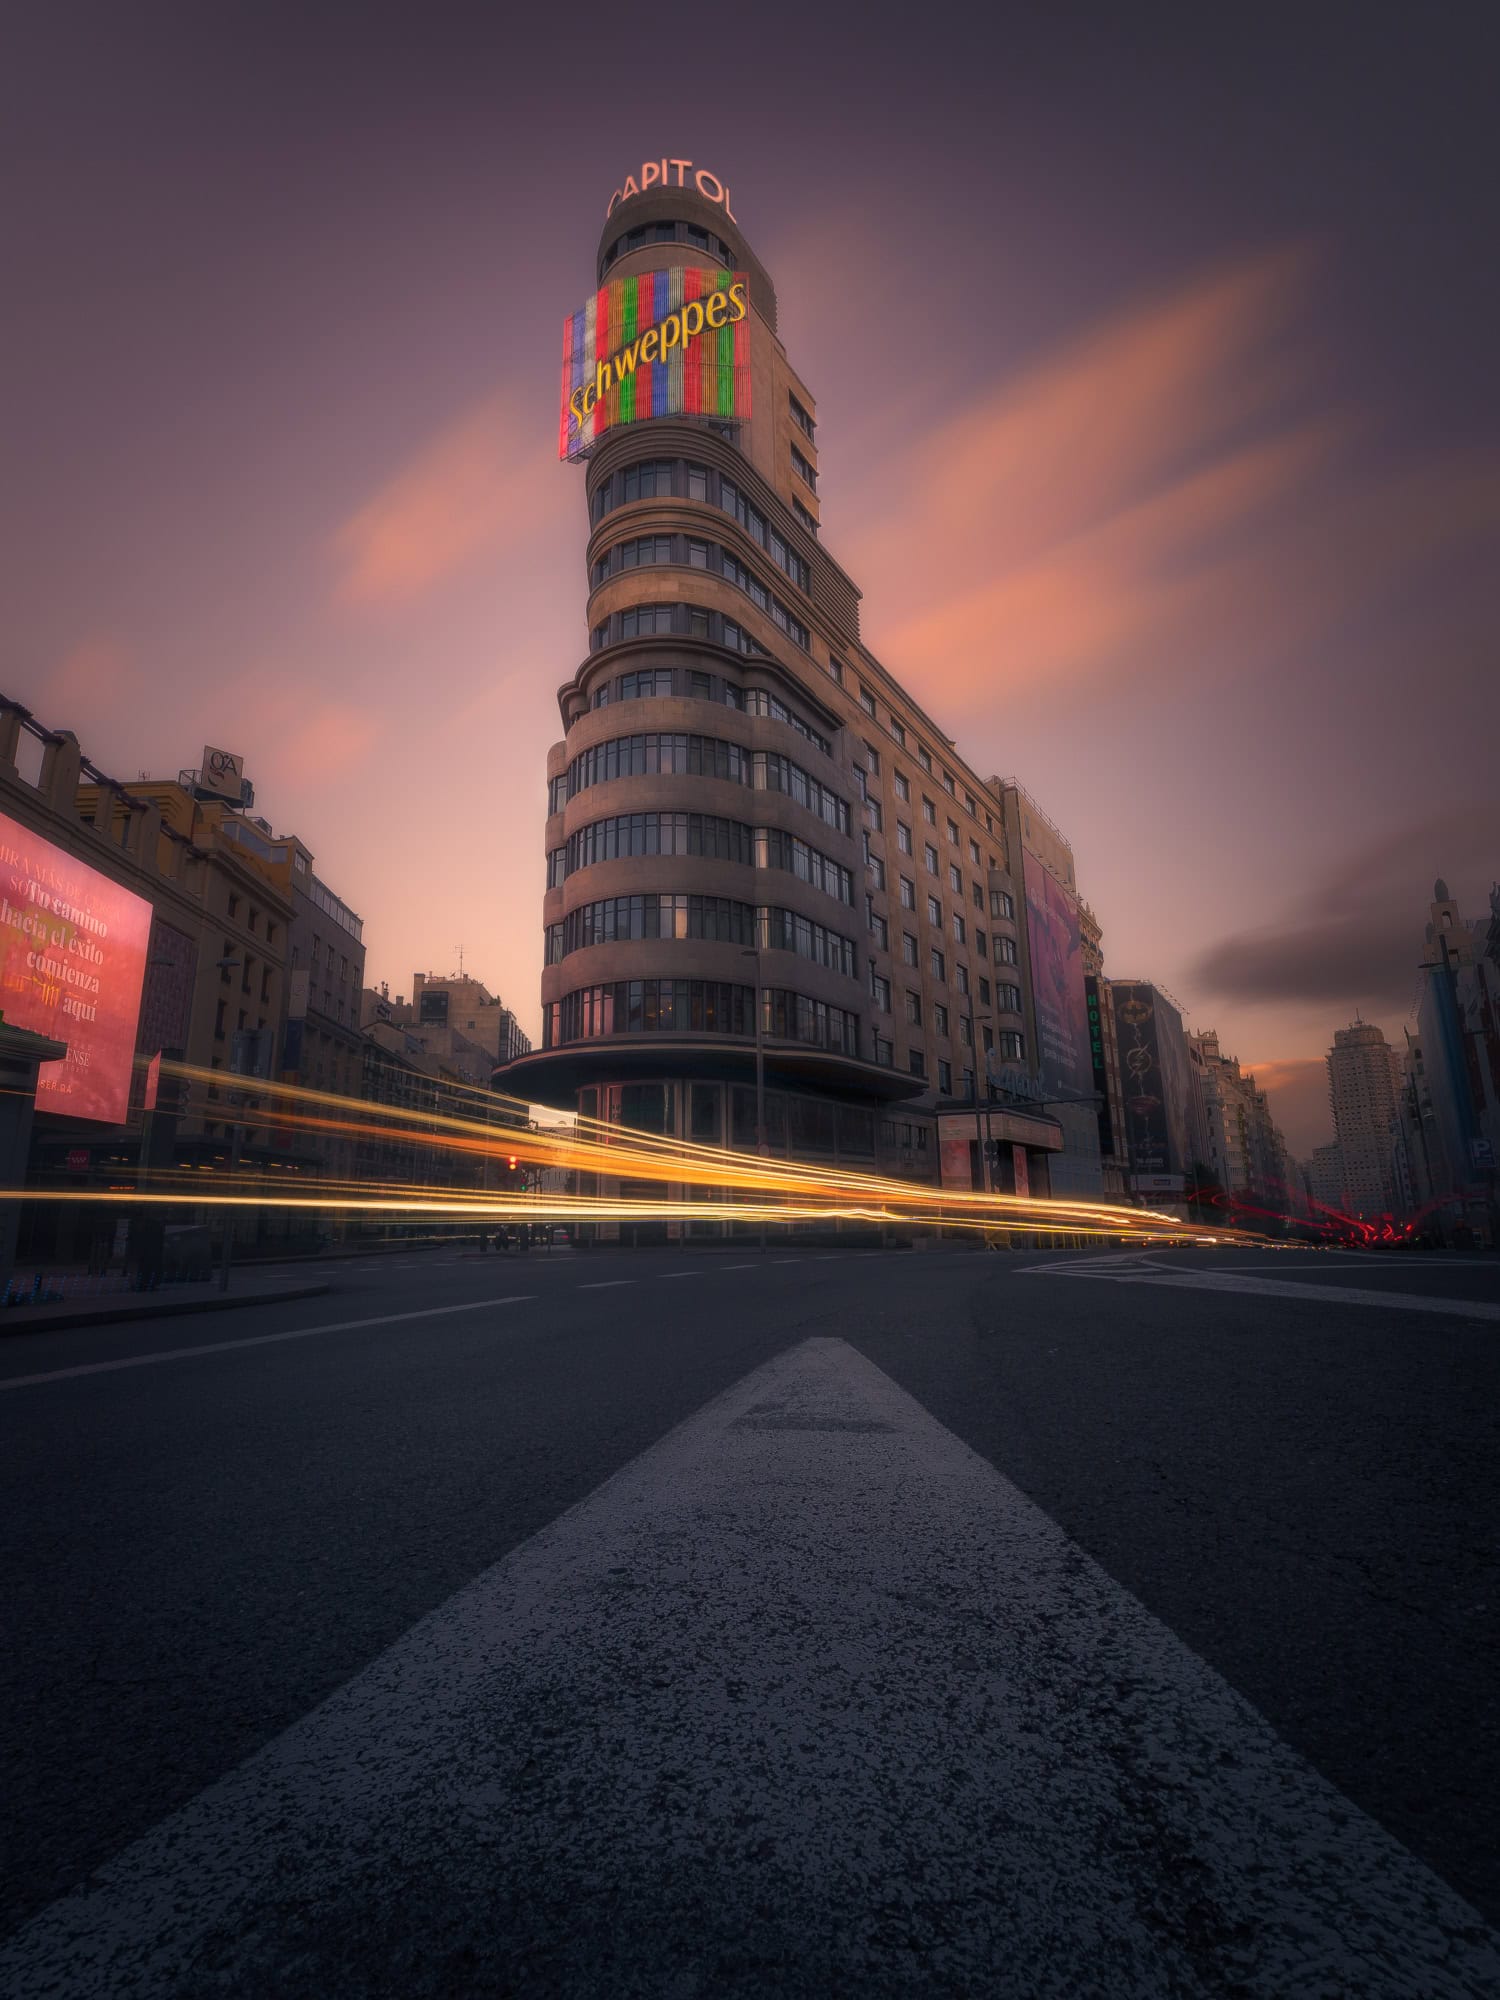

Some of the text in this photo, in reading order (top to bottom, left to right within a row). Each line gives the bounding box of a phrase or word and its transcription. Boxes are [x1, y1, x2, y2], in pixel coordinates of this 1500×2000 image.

[607, 158, 737, 225] CAPITOL
[569, 282, 748, 429] Schweppes
[1, 898, 104, 966] hacia el éxito
[52, 897, 108, 938] camino
[26, 951, 101, 995] comienza
[62, 997, 98, 1022] aquí
[1087, 993, 1104, 1071] HOTEL
[1471, 1139, 1490, 1158] P
